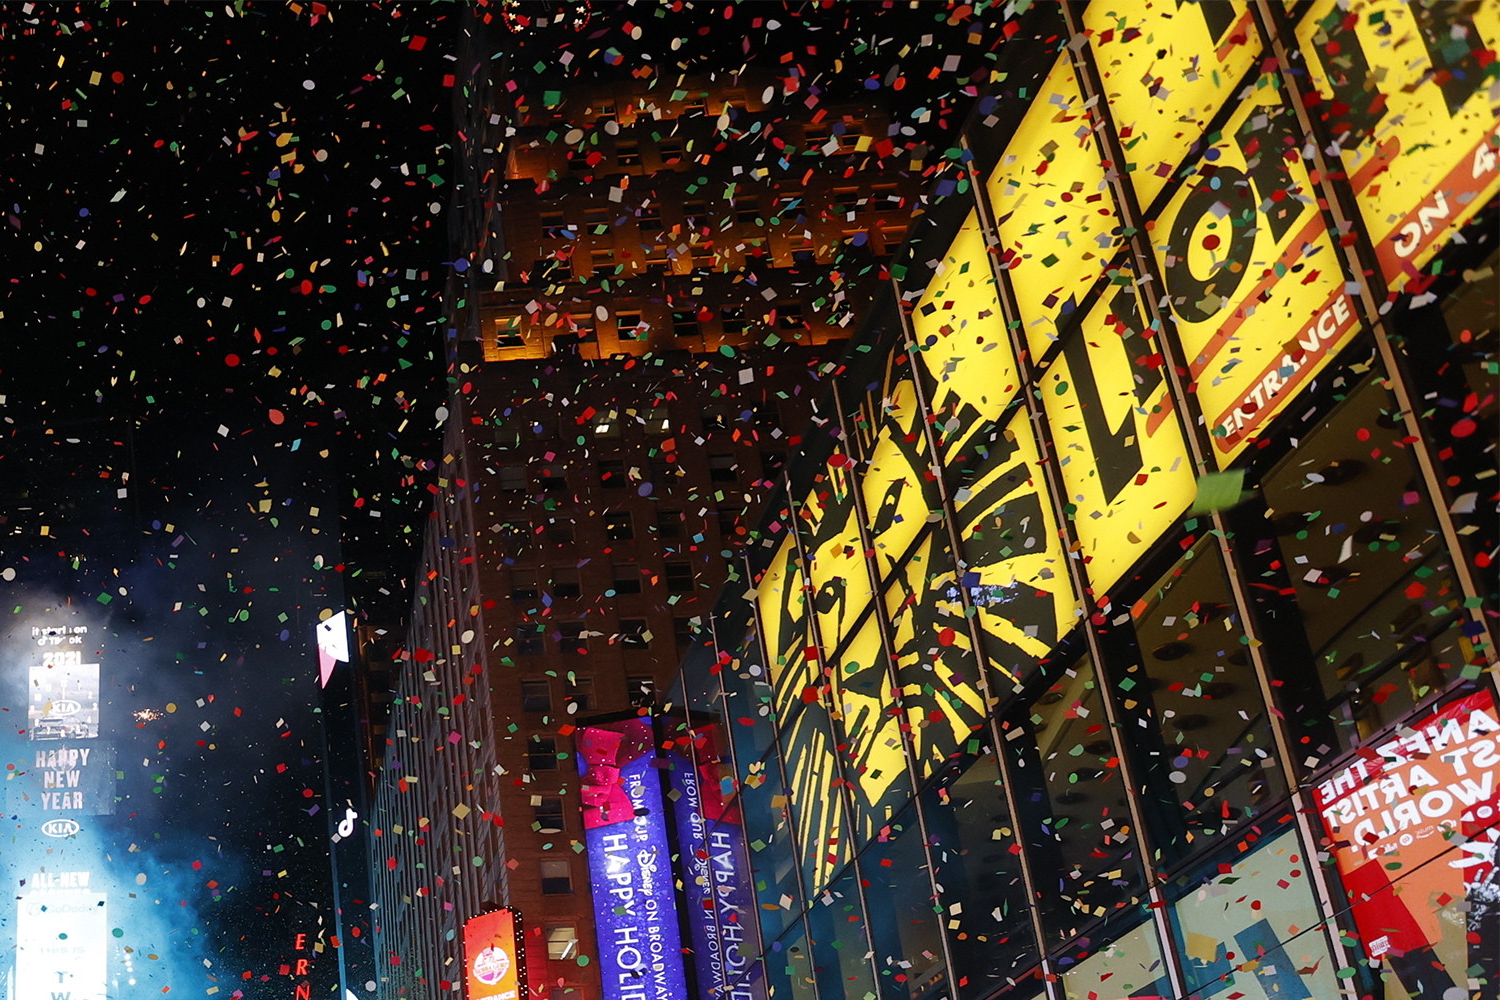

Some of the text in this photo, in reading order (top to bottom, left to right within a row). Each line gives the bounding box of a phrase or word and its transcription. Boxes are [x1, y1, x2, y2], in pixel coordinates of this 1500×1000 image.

[1221, 295, 1352, 439] ENTRANCE
[1393, 191, 1451, 258] ON
[43, 651, 82, 667] 2021
[35, 749, 90, 769] HAPPY
[44, 770, 81, 789] NEW
[41, 792, 83, 811] YEAR
[628, 774, 643, 809] FROM
[645, 899, 659, 922] ON
[31, 872, 90, 888] ALL-NEW
[602, 834, 636, 917] HAPPY
